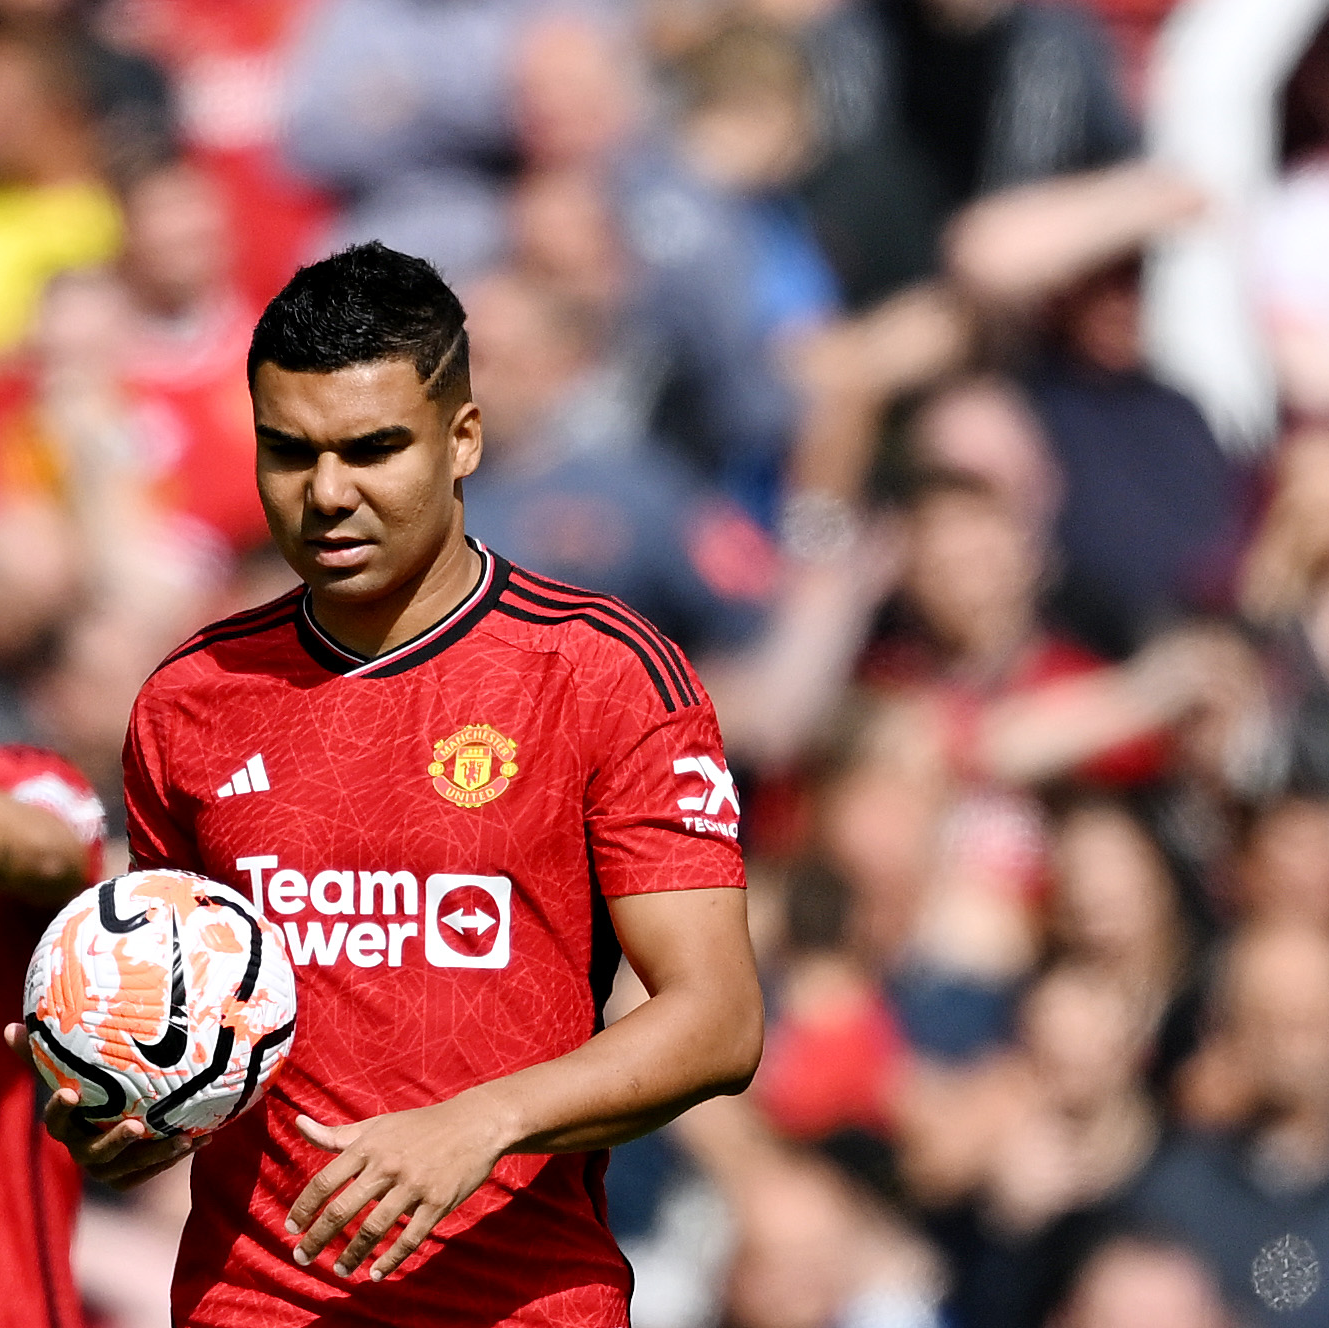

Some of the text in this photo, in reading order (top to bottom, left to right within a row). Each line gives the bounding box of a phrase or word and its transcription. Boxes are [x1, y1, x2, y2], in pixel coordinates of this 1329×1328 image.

[439, 730, 511, 757] MANCHESTER
[445, 786, 495, 803] UNITED
[236, 855, 418, 915] Team
[283, 921, 419, 968] wer
